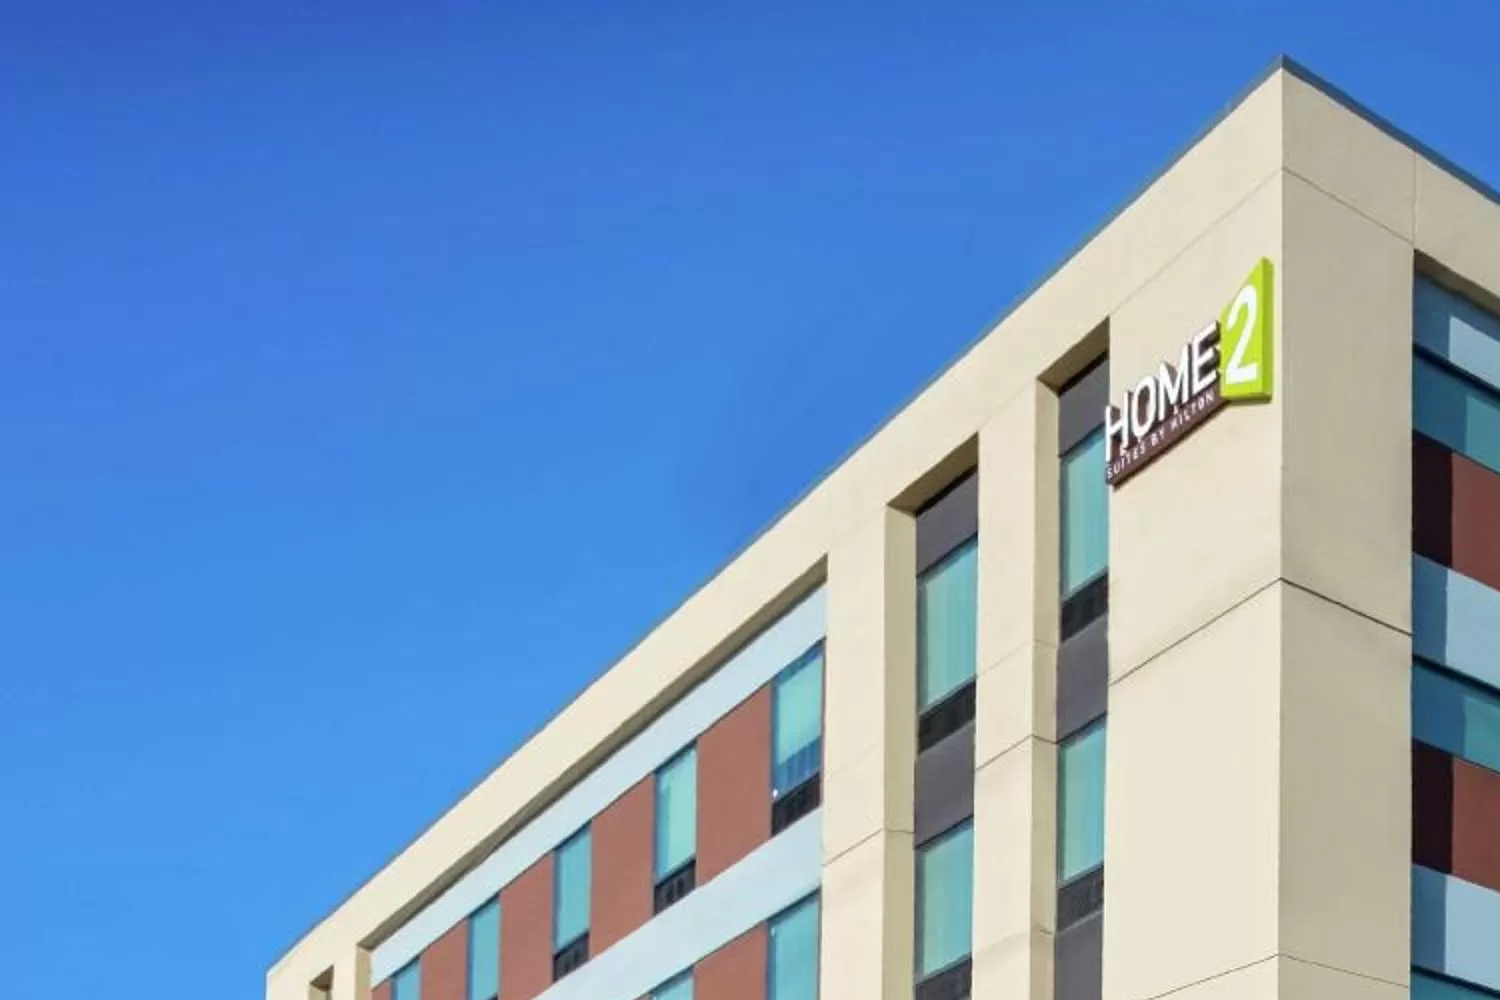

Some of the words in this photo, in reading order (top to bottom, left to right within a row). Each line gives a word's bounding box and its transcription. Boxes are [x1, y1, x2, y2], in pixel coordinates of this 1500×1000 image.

[1106, 442, 1147, 481] SUITES
[1150, 429, 1165, 446] BY
[1169, 389, 1215, 431] HILTON
